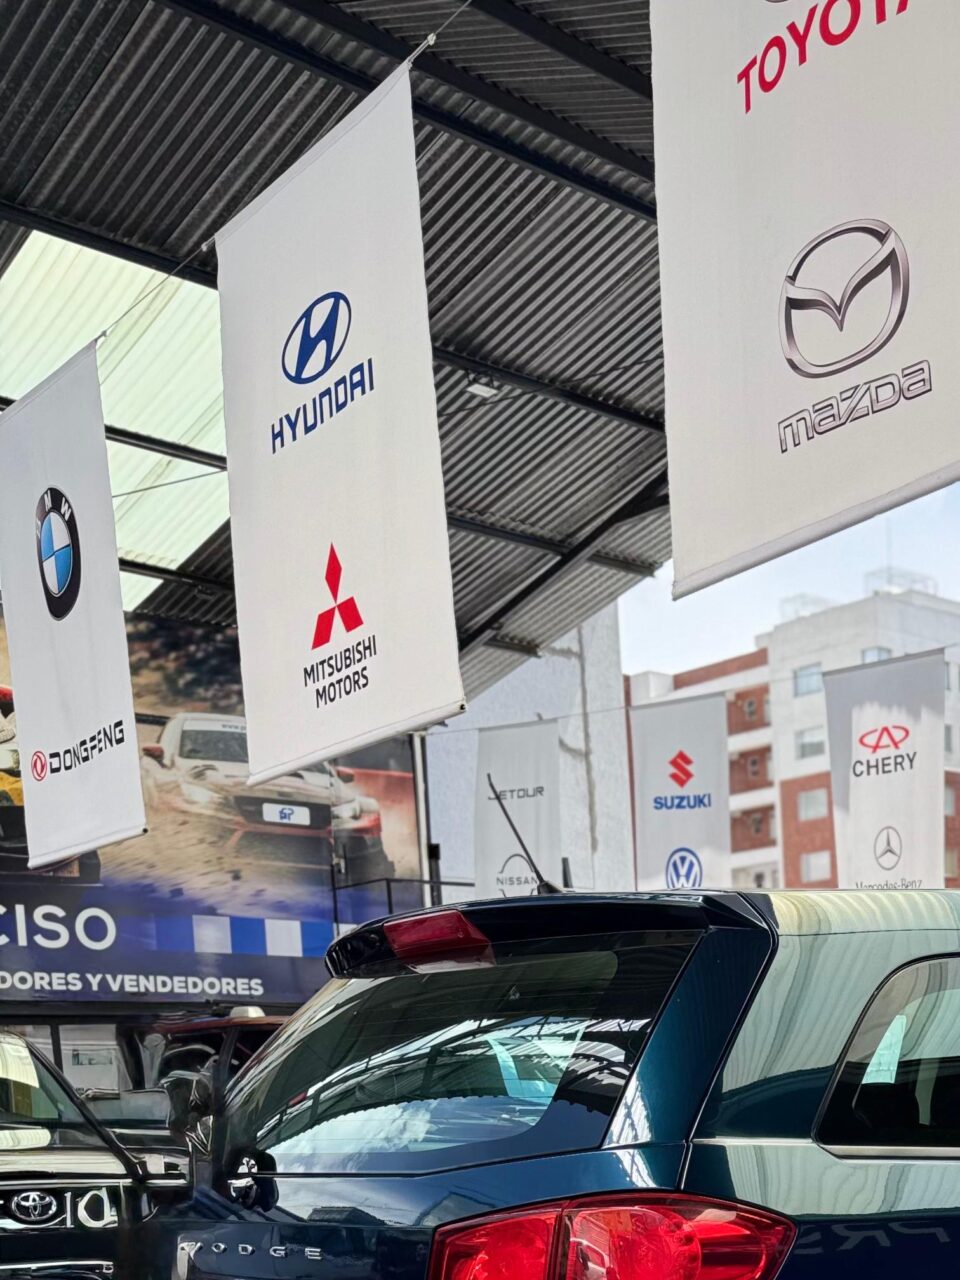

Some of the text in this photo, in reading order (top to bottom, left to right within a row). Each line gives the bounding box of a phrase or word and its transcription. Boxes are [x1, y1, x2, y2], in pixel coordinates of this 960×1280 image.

[737, 0, 908, 114] TOYO
[271, 357, 375, 455] HYUNDAI
[303, 634, 377, 687] MITSUBISHI
[315, 665, 369, 709] MOTORS
[49, 719, 125, 774] DONGFENG
[852, 751, 917, 778] CHERY
[487, 786, 545, 801] JETOUR
[653, 793, 711, 810] SUZUKI
[496, 877, 538, 886] NISSAN
[86, 973, 102, 991] Y
[104, 974, 264, 996] VENDEDORES
